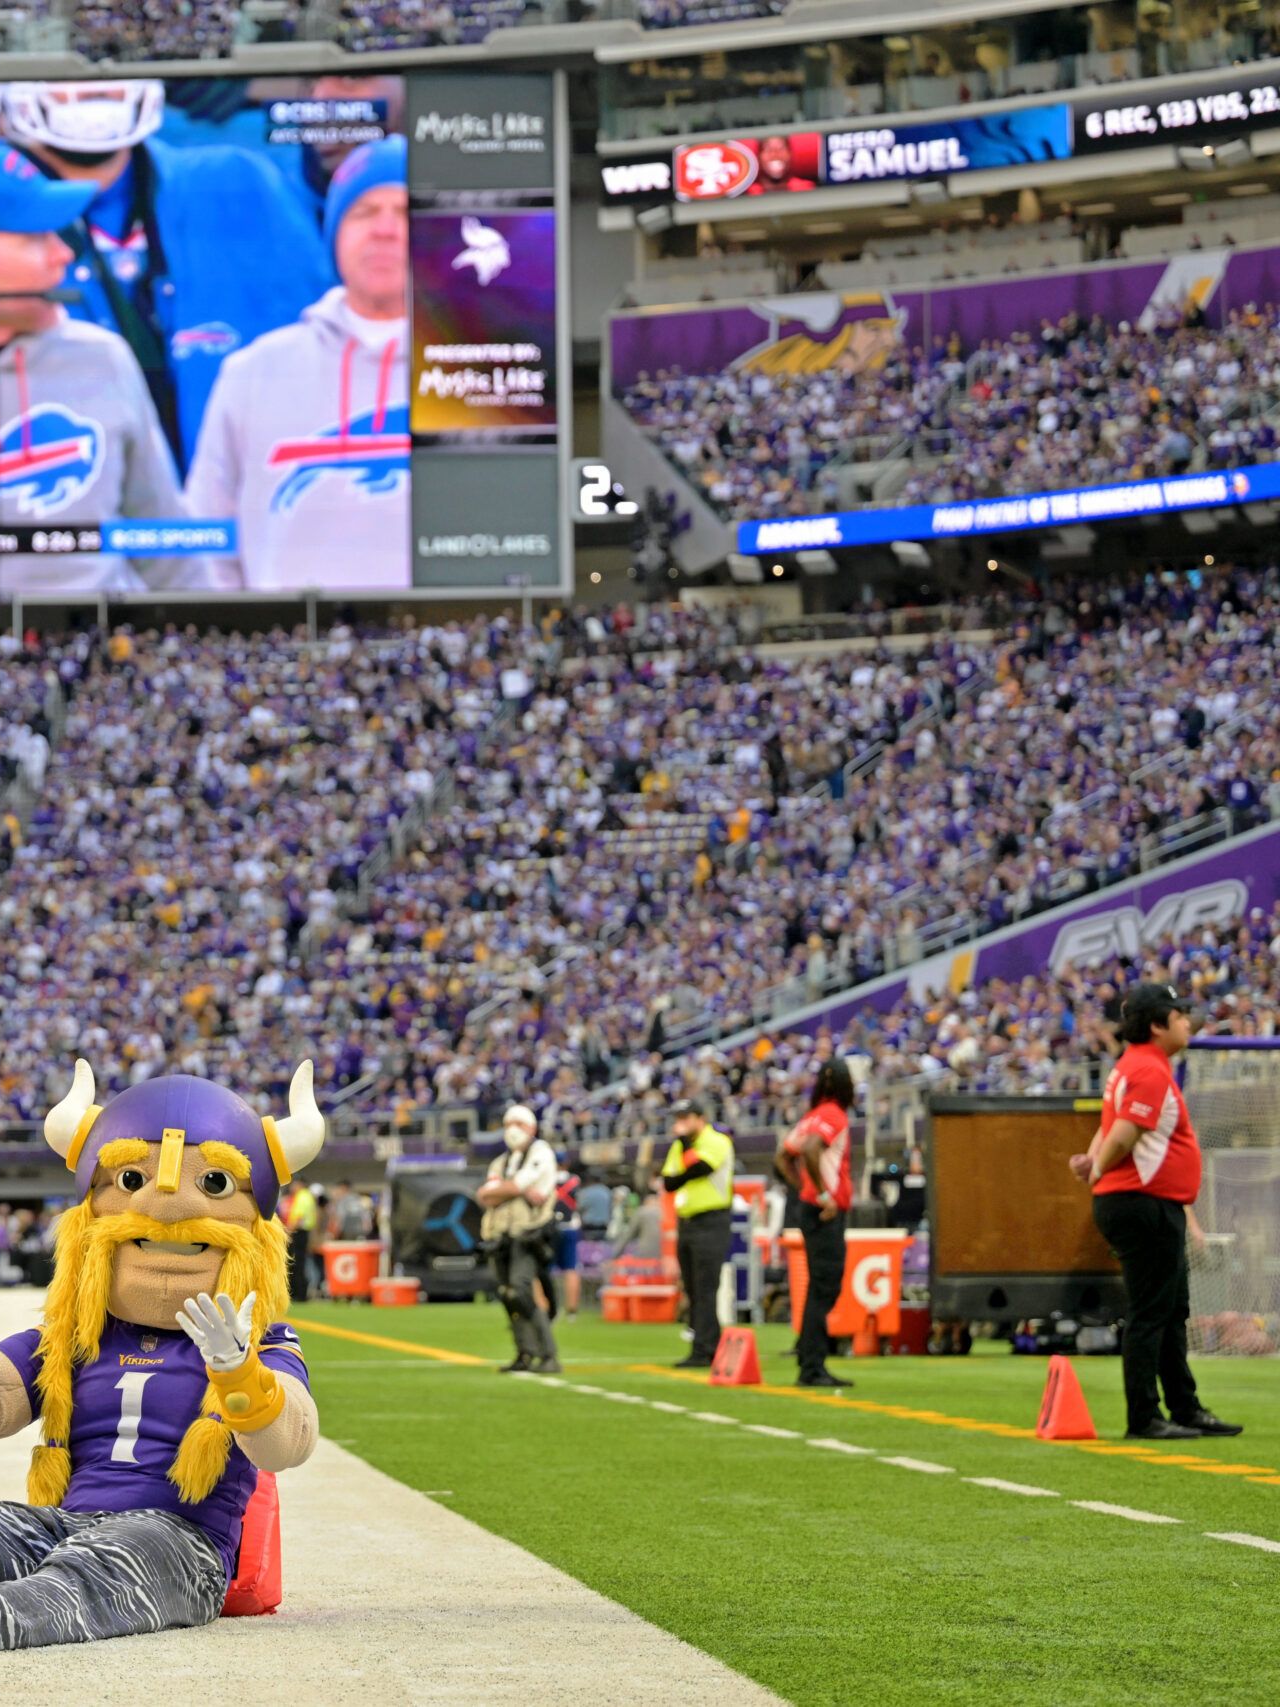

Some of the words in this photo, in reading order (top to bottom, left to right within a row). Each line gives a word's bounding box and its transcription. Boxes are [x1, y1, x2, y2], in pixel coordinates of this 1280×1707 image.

[1086, 112, 1103, 138] 6
[1104, 105, 1157, 136] REC,
[1157, 99, 1197, 128] 133
[1197, 91, 1249, 122] YDS,
[602, 163, 669, 194] WR
[828, 137, 969, 181] SAMUEL
[852, 1253, 891, 1313] G
[111, 1371, 157, 1464] 1
